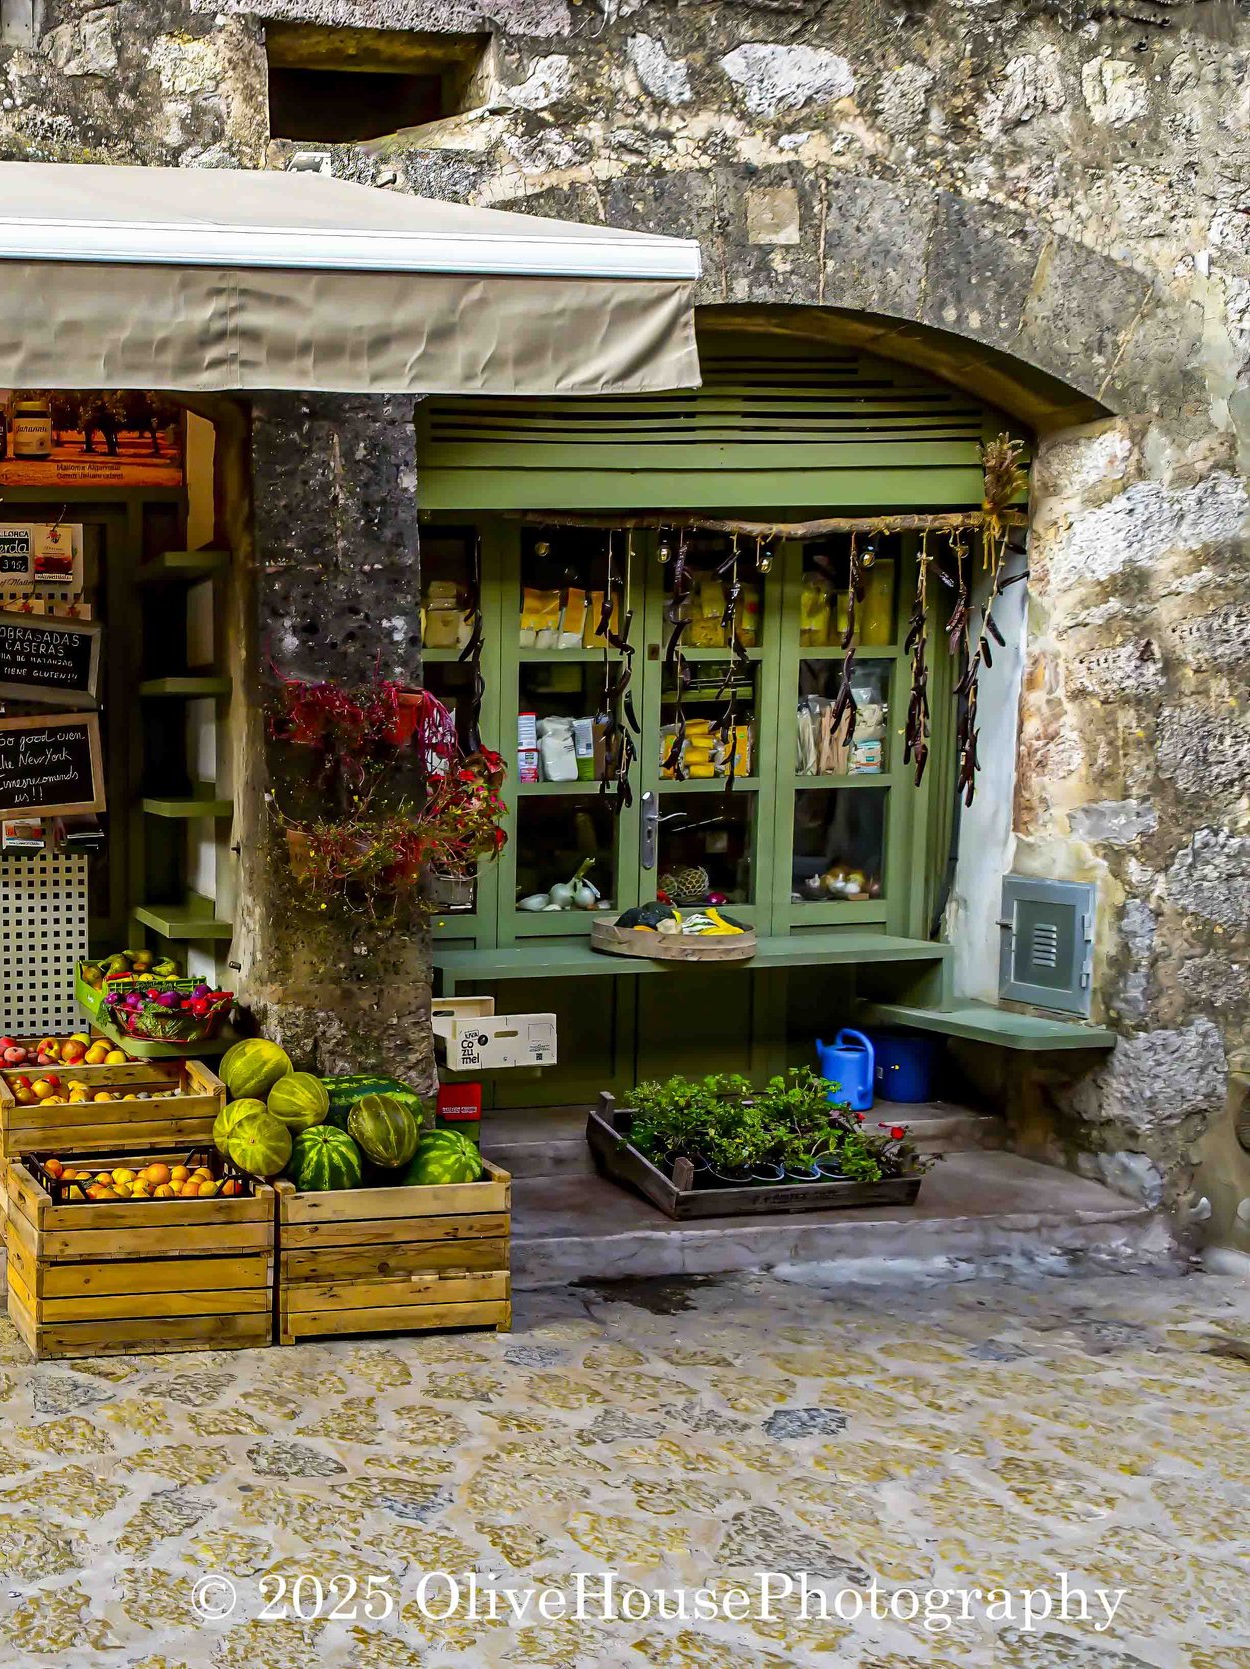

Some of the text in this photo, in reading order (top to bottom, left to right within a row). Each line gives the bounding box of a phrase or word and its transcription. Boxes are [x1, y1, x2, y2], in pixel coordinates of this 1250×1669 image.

[5, 640, 64, 657] CASERAS
[4, 666, 28, 676] TIENE
[19, 730, 56, 751] good
